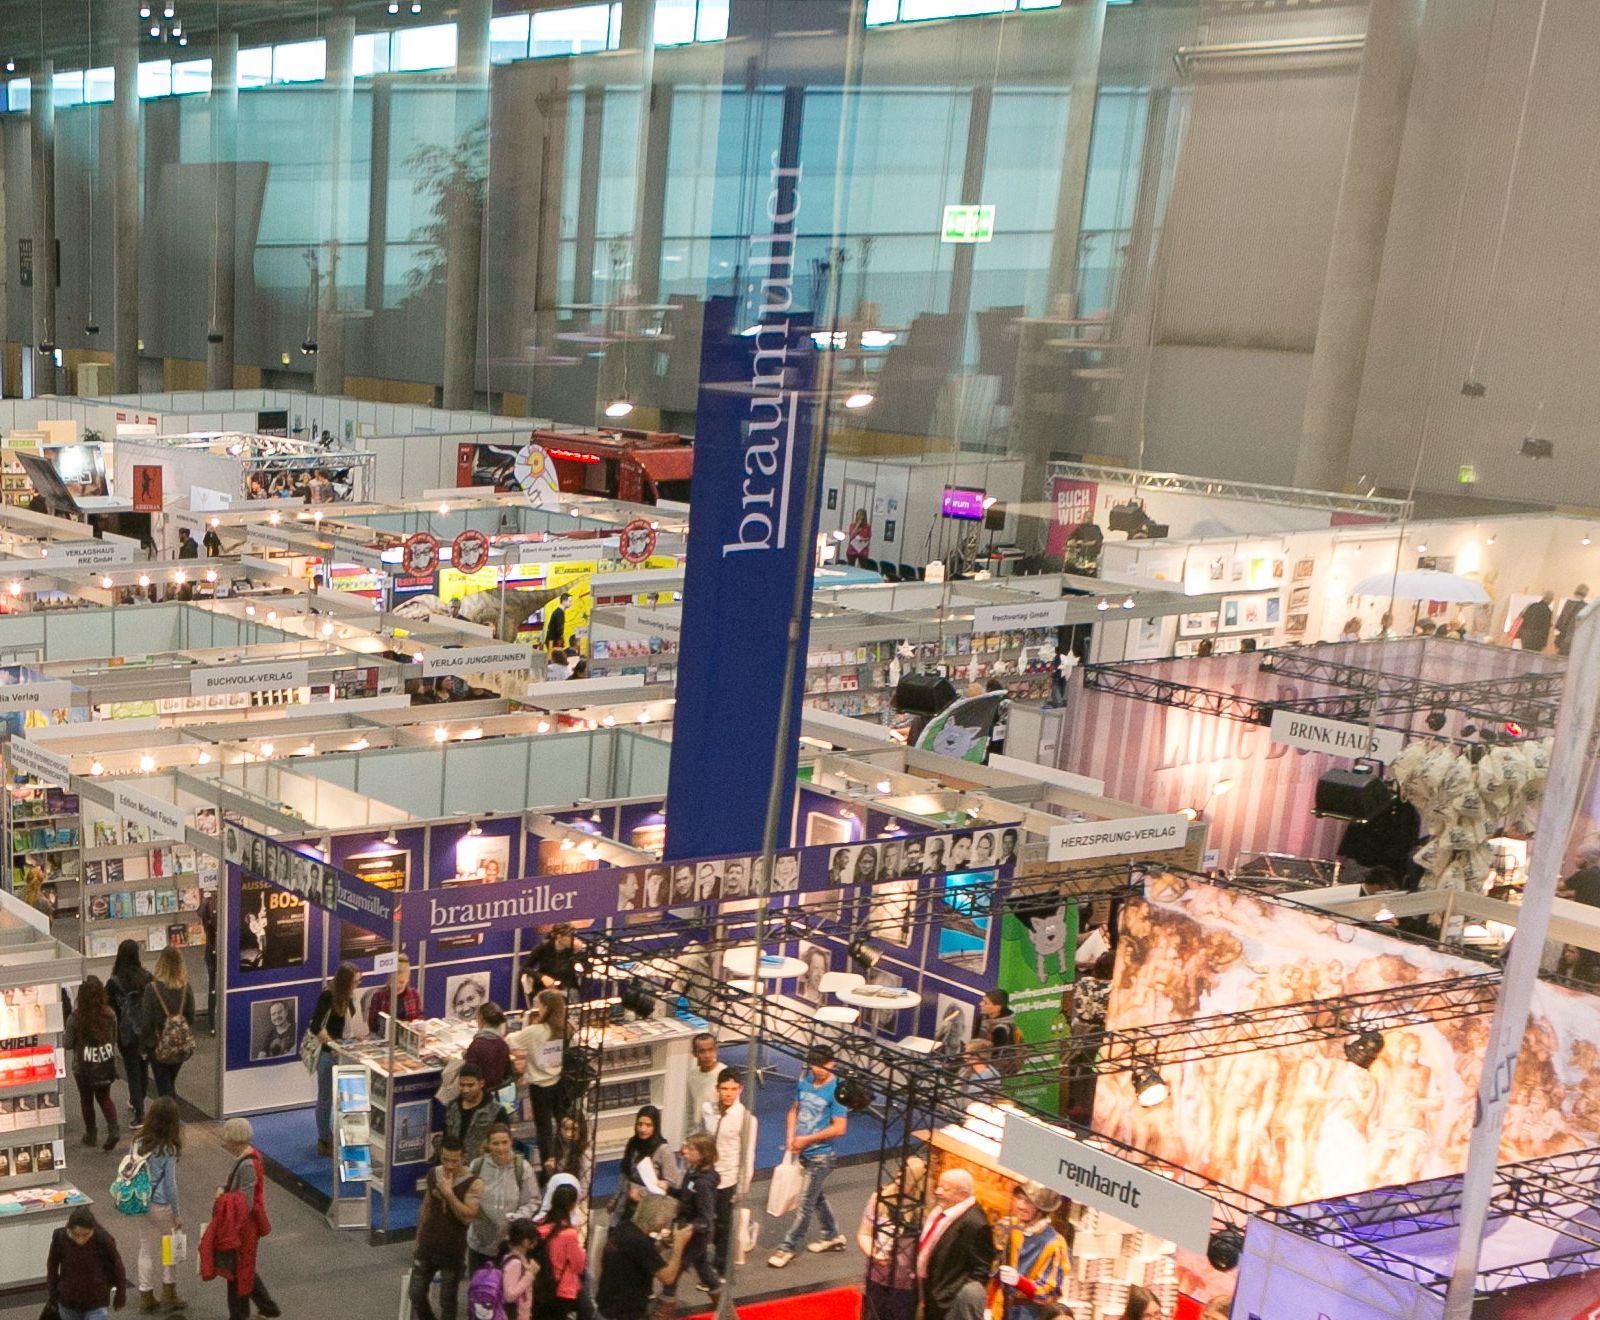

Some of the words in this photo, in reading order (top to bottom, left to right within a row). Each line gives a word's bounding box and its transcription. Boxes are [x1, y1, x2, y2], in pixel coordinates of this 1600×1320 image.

[722, 150, 803, 557] braumüller
[1057, 489, 1090, 507] BUCH
[65, 547, 114, 557] VERLAGSHAUS
[430, 656, 463, 667] VERLAG
[465, 652, 527, 665] JUNGBRUNNEN
[206, 671, 293, 687] BUCHVOLK-VERLAG
[13, 691, 40, 704] Verlag
[1289, 721, 1331, 744] BRINK
[1335, 731, 1380, 752] HAUS
[1060, 826, 1176, 849] HERZSPRUNG-VERLAG
[269, 891, 308, 910] BOS
[336, 880, 391, 919] braumüller
[431, 887, 578, 926] braumüller
[83, 1043, 114, 1063] NEER
[1058, 1156, 1141, 1210] reinhardt
